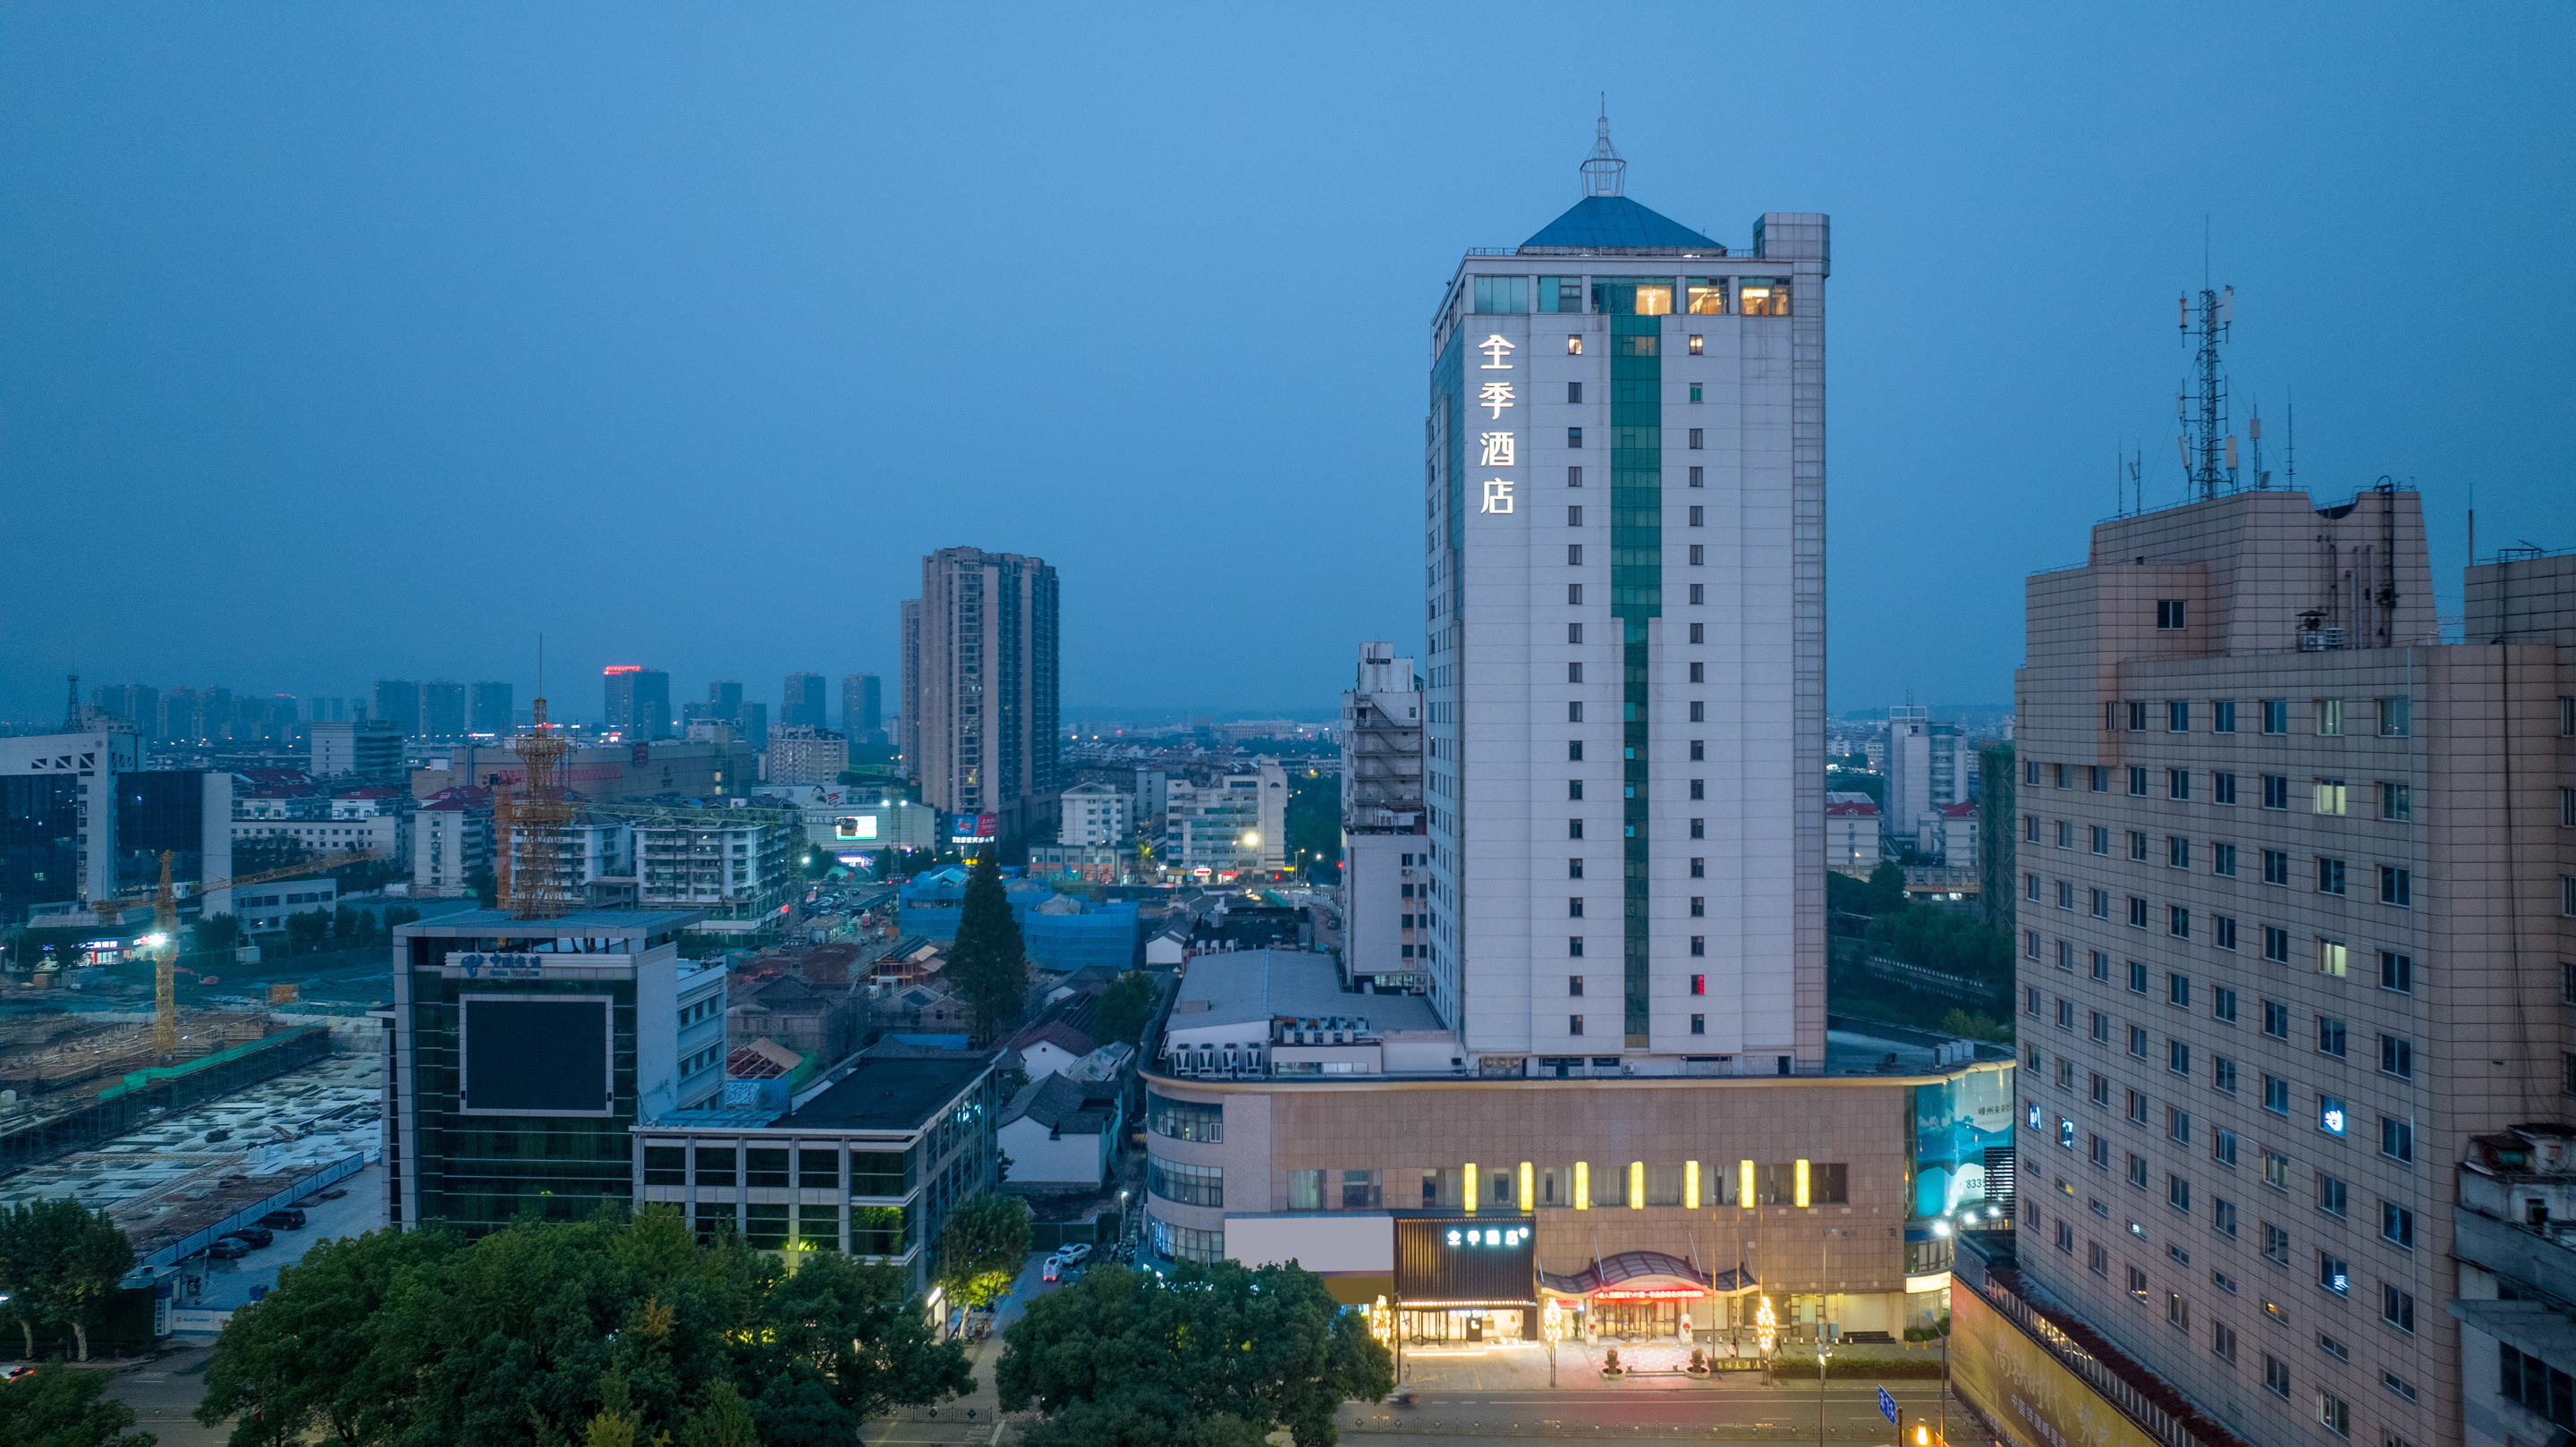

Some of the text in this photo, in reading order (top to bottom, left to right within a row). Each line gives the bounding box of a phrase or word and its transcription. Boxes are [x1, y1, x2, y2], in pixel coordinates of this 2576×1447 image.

[1479, 334, 1515, 514] 全季酒店
[490, 952, 540, 968] 中国电信
